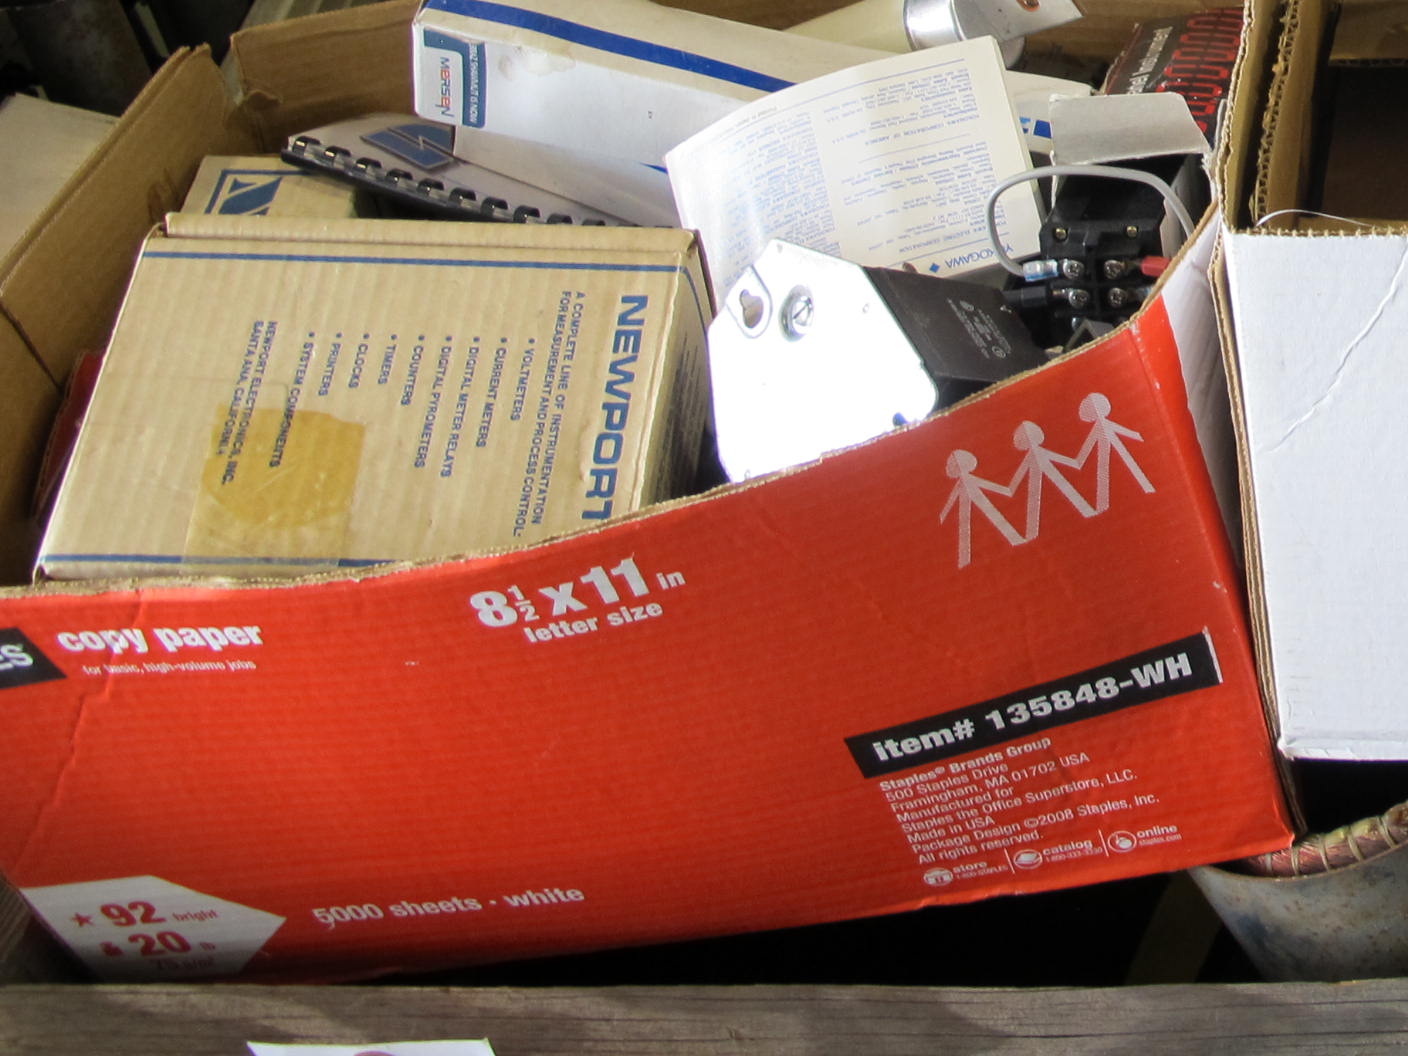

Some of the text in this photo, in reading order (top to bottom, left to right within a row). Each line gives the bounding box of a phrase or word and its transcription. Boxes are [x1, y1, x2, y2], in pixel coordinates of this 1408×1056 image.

[469, 104, 478, 124] NOW
[558, 290, 572, 313] FOR
[244, 320, 265, 358] SANTA
[255, 320, 278, 375] NEWPORT
[541, 313, 567, 396] MEASUREMENT
[318, 342, 341, 397] PRINTERS
[347, 343, 369, 389] CLOCKS
[377, 344, 397, 385] TIMERS
[400, 345, 424, 406] COUNTERS
[510, 347, 535, 421] VOLTMETERS
[269, 341, 314, 468] SYSTEM COMPONENTS
[414, 345, 452, 468] DIGITAL PYROMETERS
[440, 346, 480, 478] DIGITAL METER RELAYS
[475, 346, 507, 448] CURRENT METERS
[531, 290, 586, 525] A COMPLETE LINE OF INSTRUMENTATION
[536, 395, 550, 420] AND
[581, 295, 649, 520] NEWPORT
[526, 421, 545, 475] PROCESS
[538, 581, 589, 617] x
[580, 557, 651, 597] 11
[655, 570, 687, 590] in
[57, 628, 149, 655] copy
[153, 624, 263, 652] paper
[523, 601, 664, 643] letter size
[82, 659, 257, 675] for basic, high-volume jobs
[984, 651, 1193, 731] 135848-WH
[948, 752, 1004, 774] Brands
[1006, 737, 1053, 758] Group
[984, 774, 1010, 789] MA
[1011, 760, 1057, 782] 01702
[1059, 751, 1091, 768] USA
[885, 762, 1009, 803] 500 Staples Drive
[901, 767, 1139, 833] Staples the Office Superstore, LLC.
[896, 785, 1015, 822] Manufactured for
[911, 833, 971, 854] Package
[972, 822, 1021, 841] Design
[1076, 798, 1133, 817] Staples,
[1133, 793, 1161, 807] Inc.
[907, 815, 996, 844] Made in USA
[918, 830, 1044, 865] All rights reserved.
[1042, 839, 1094, 856] catalog
[1136, 823, 1179, 840] online
[952, 860, 989, 875] store
[99, 900, 219, 927] 92 bright
[311, 887, 586, 924] 5000 sheets white
[127, 930, 192, 956] 20
